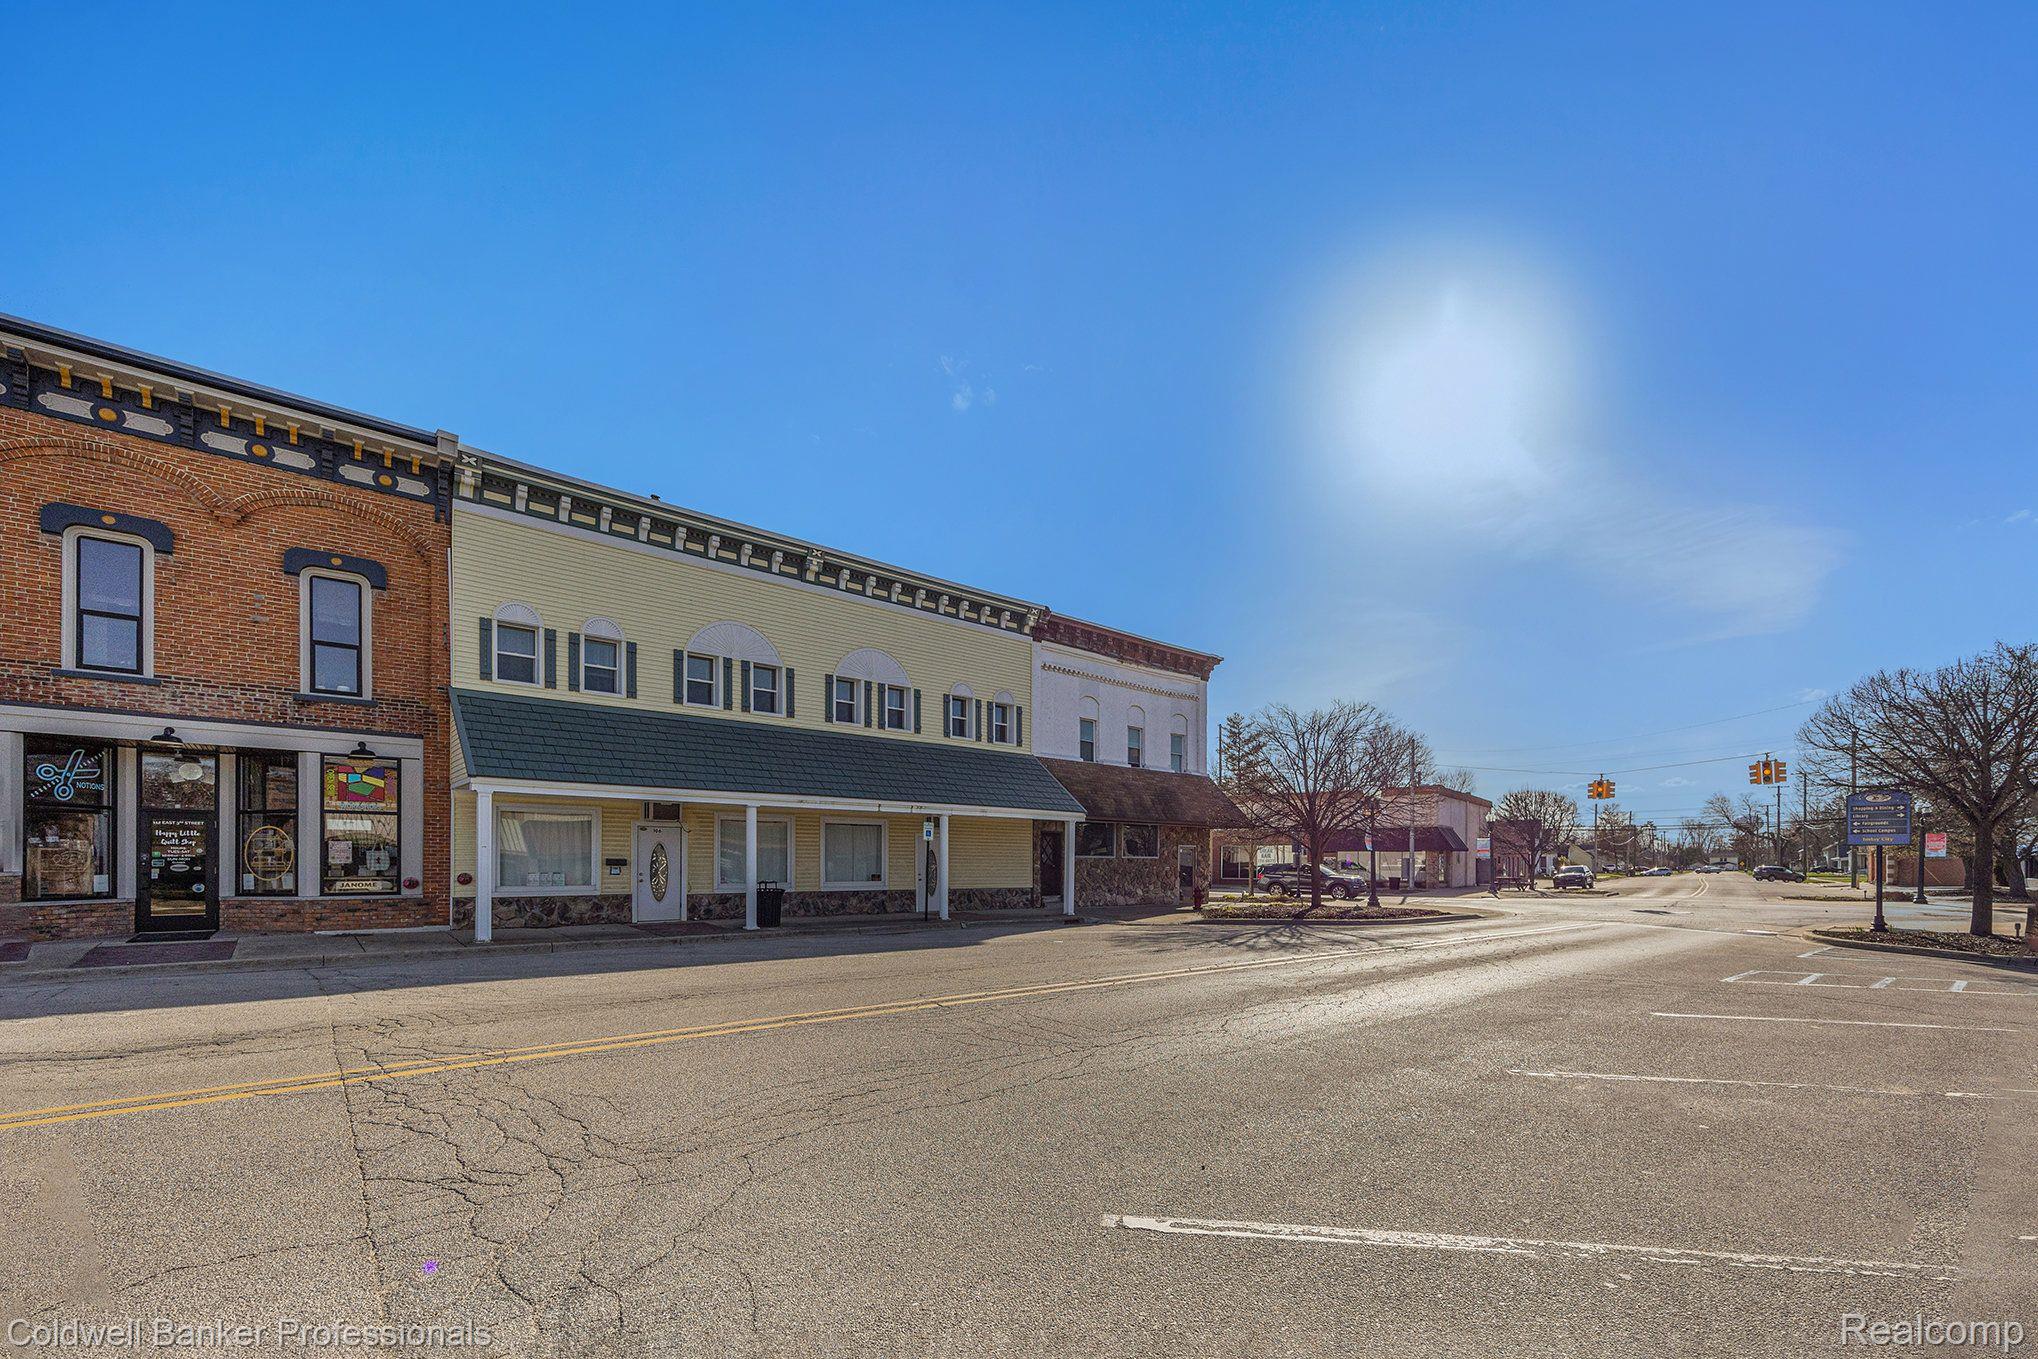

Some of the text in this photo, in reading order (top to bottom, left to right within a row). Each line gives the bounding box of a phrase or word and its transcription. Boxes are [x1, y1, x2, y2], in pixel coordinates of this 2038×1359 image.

[76, 781, 105, 791] NOTIONS
[155, 829, 201, 838] Happy Little
[160, 838, 197, 847] Quilt Shop
